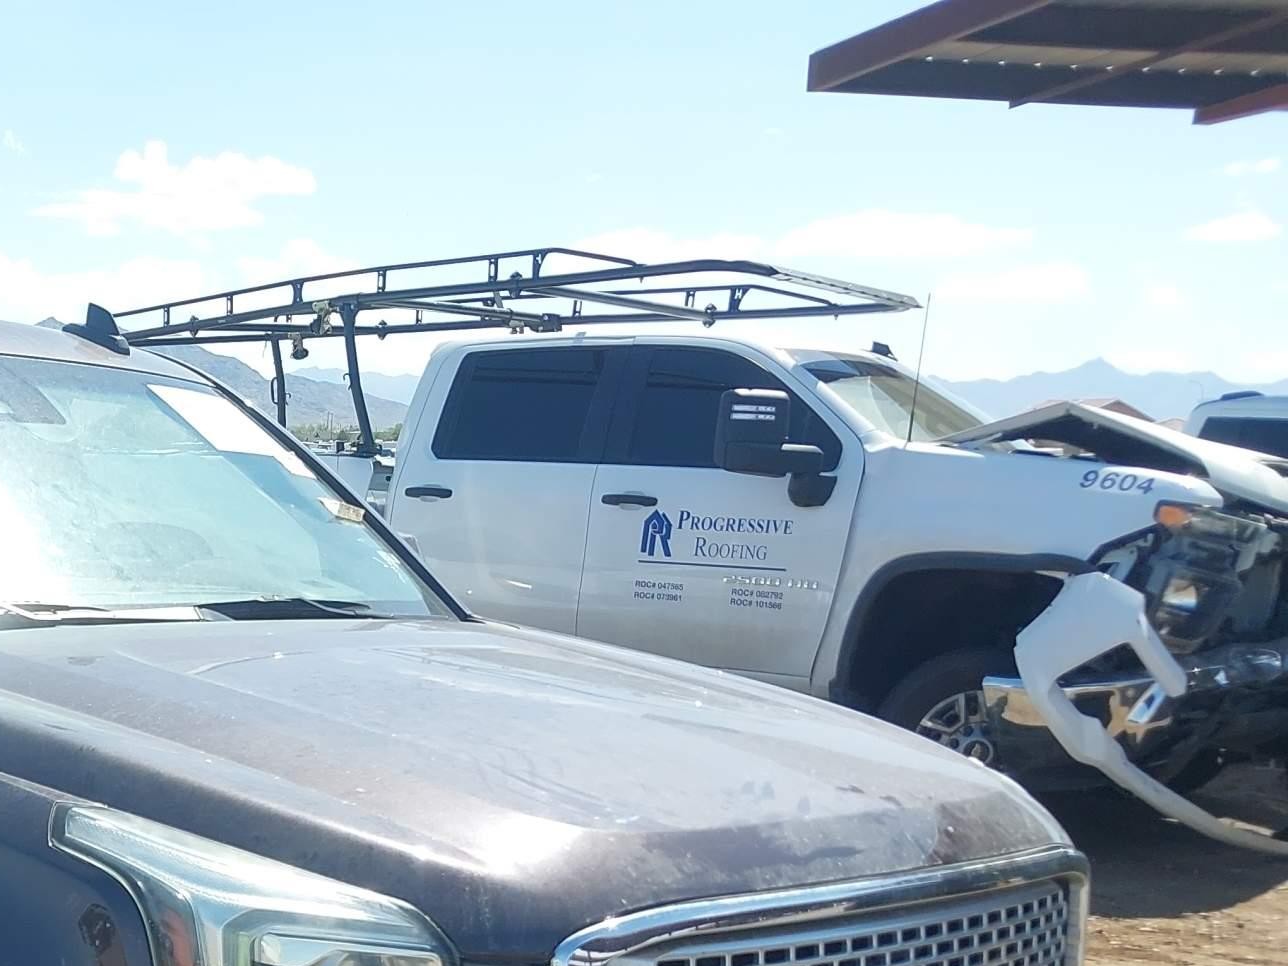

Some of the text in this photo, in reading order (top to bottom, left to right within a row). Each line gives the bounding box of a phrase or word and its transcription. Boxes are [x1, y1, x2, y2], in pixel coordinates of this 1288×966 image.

[1079, 469, 1155, 494] 9604
[677, 510, 794, 535] PROGRESSIVE
[694, 536, 768, 561] ROOFING
[730, 597, 752, 607] ROC#
[731, 588, 753, 597] ROC#
